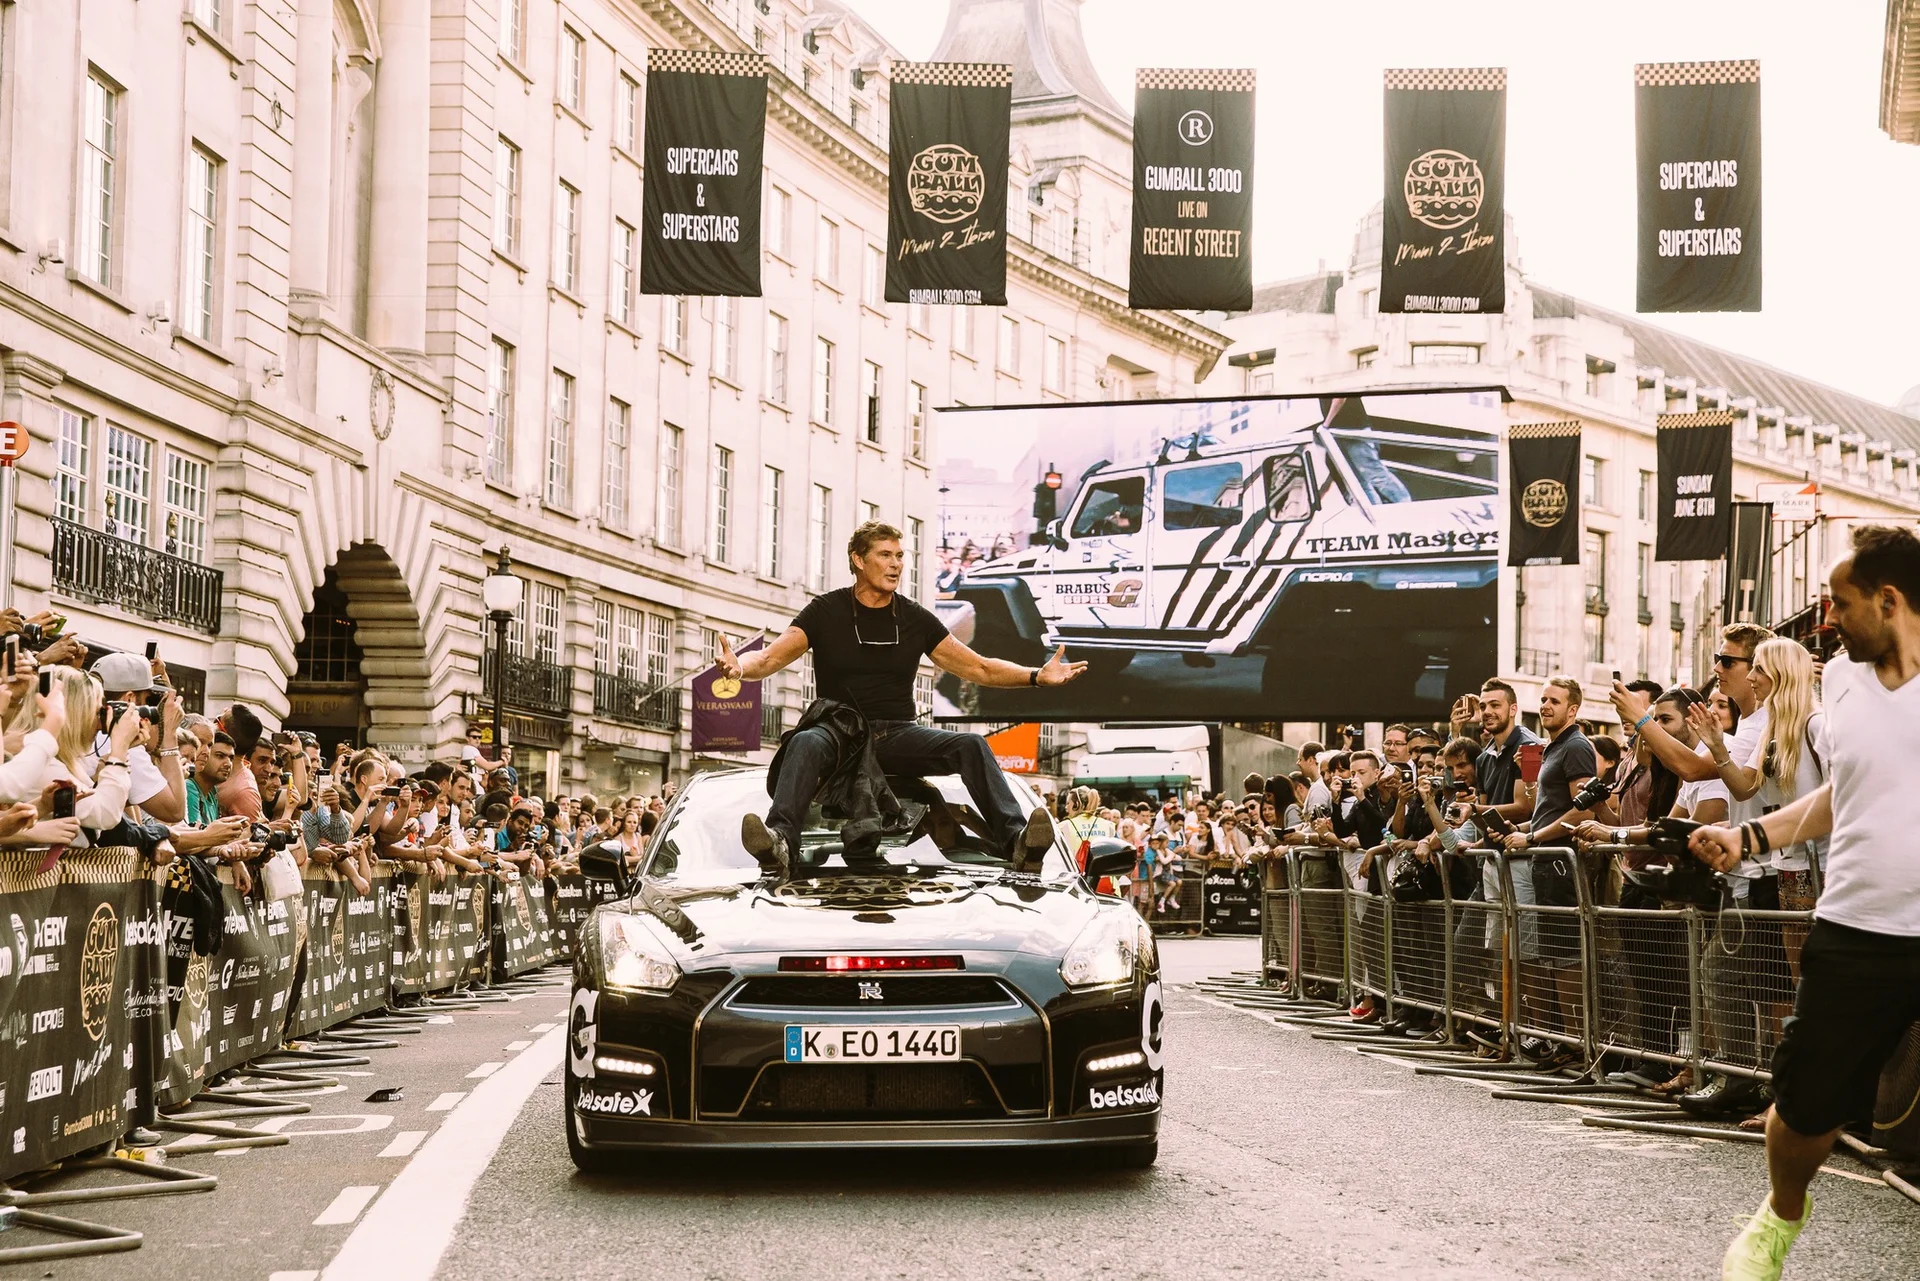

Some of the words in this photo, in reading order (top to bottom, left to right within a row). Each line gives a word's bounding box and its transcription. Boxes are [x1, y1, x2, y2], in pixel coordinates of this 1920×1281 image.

[667, 147, 739, 176] SUPERCARS
[914, 151, 979, 174] GUM
[1410, 156, 1477, 178] GUM
[911, 172, 982, 194] BALL
[1145, 165, 1206, 192] GUMBALL
[1207, 167, 1242, 194] 3000
[1659, 159, 1738, 190] SUPERCARS
[696, 182, 706, 208] &
[1407, 177, 1480, 200] BALL
[1177, 201, 1195, 219] LIVE
[1196, 201, 1208, 219] ON
[1694, 196, 1706, 222] &
[662, 212, 740, 243] SUPERSTARS
[898, 237, 936, 262] Miami
[938, 230, 958, 249] 2
[956, 217, 996, 250] Ibiza
[1143, 227, 1192, 257] REGENT
[1194, 228, 1242, 258] STREET
[1394, 242, 1434, 266] Miami
[1437, 236, 1455, 256] 2
[1455, 221, 1495, 255] Ibiza
[1658, 226, 1742, 258] SUPERSTARS
[1403, 294, 1481, 312] GUMBALL3000.COM
[1676, 474, 1714, 495] SUNDAY
[1673, 497, 1697, 518] JUNE
[1696, 497, 1716, 517] 8TH
[1305, 534, 1380, 554] TEAM
[1055, 583, 1111, 595] BRABUS
[1063, 595, 1109, 605] SUPER
[789, 1047, 798, 1056] D
[804, 1031, 822, 1057] K
[887, 1030, 957, 1057] 1440
[29, 1069, 61, 1097] REVOLT
